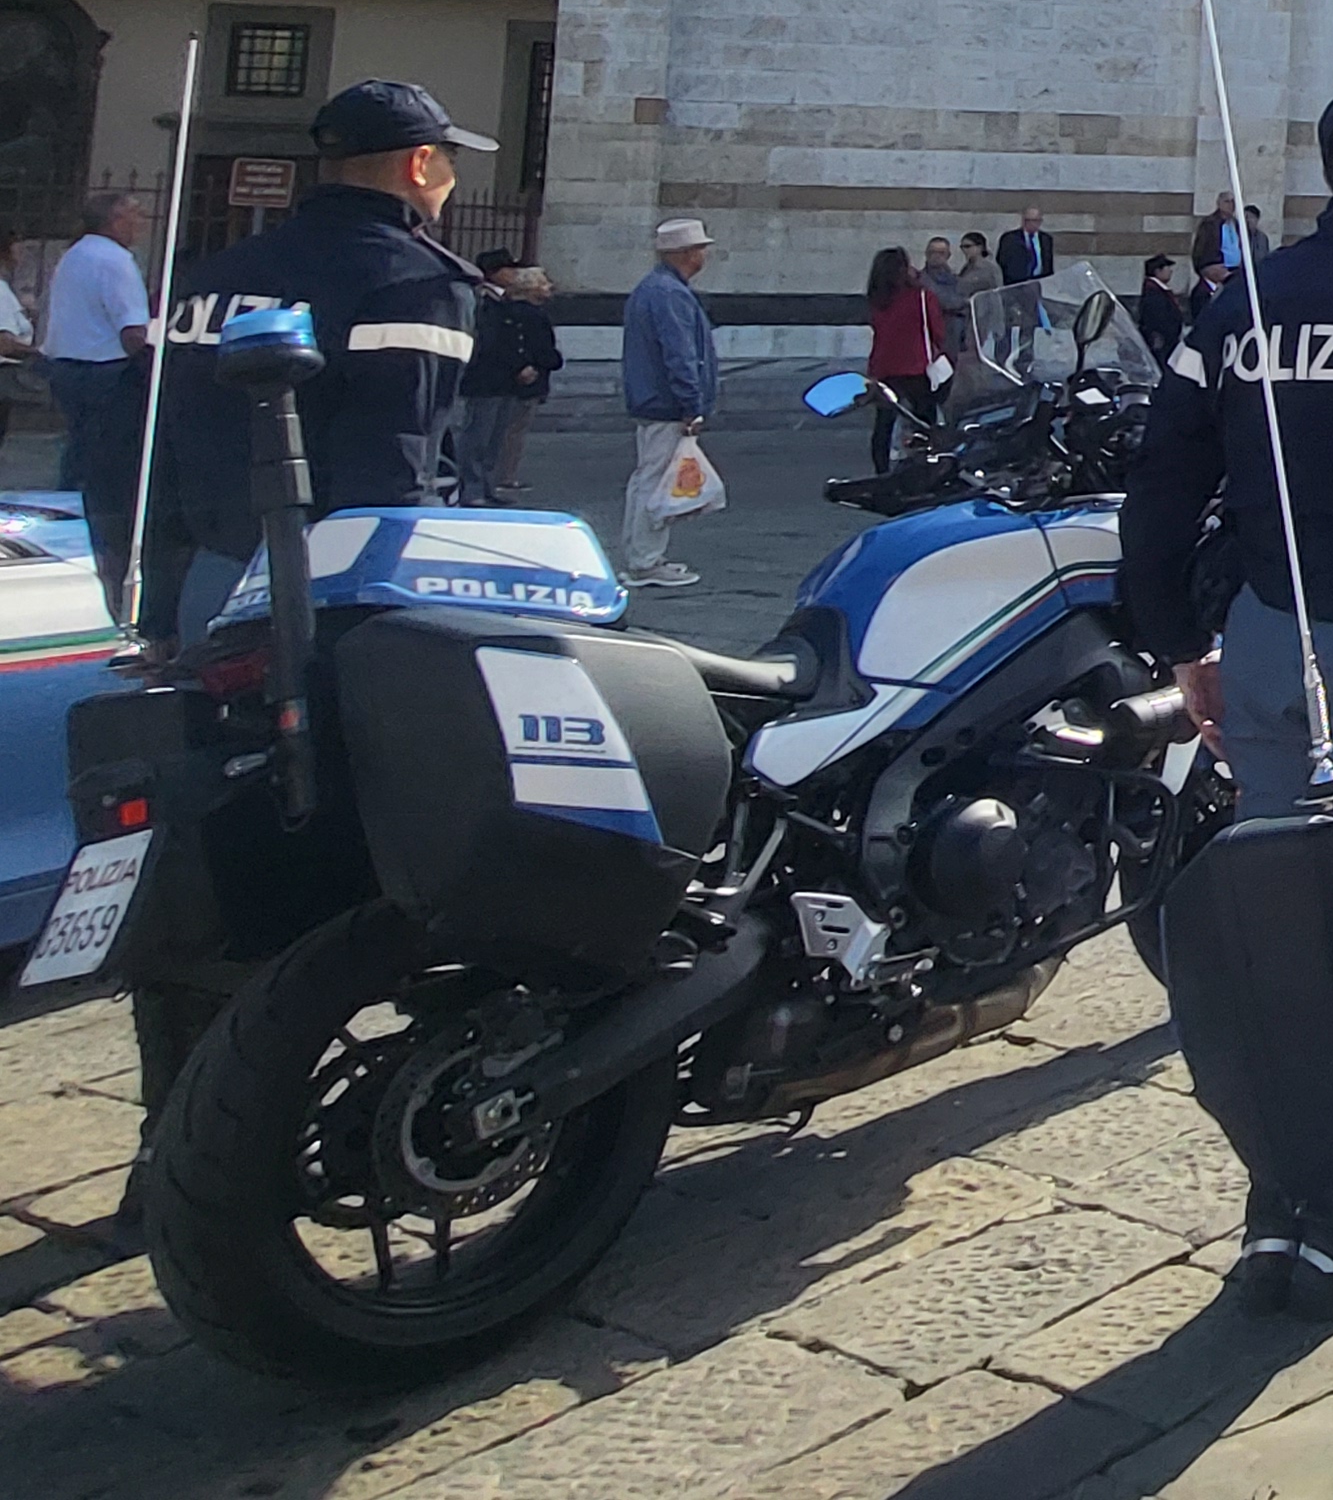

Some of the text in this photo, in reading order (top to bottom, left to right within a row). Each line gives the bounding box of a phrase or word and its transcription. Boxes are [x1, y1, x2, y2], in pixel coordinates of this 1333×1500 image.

[416, 576, 594, 609] POLIZIA
[519, 713, 605, 746] 113
[66, 857, 137, 894] POLIZIA
